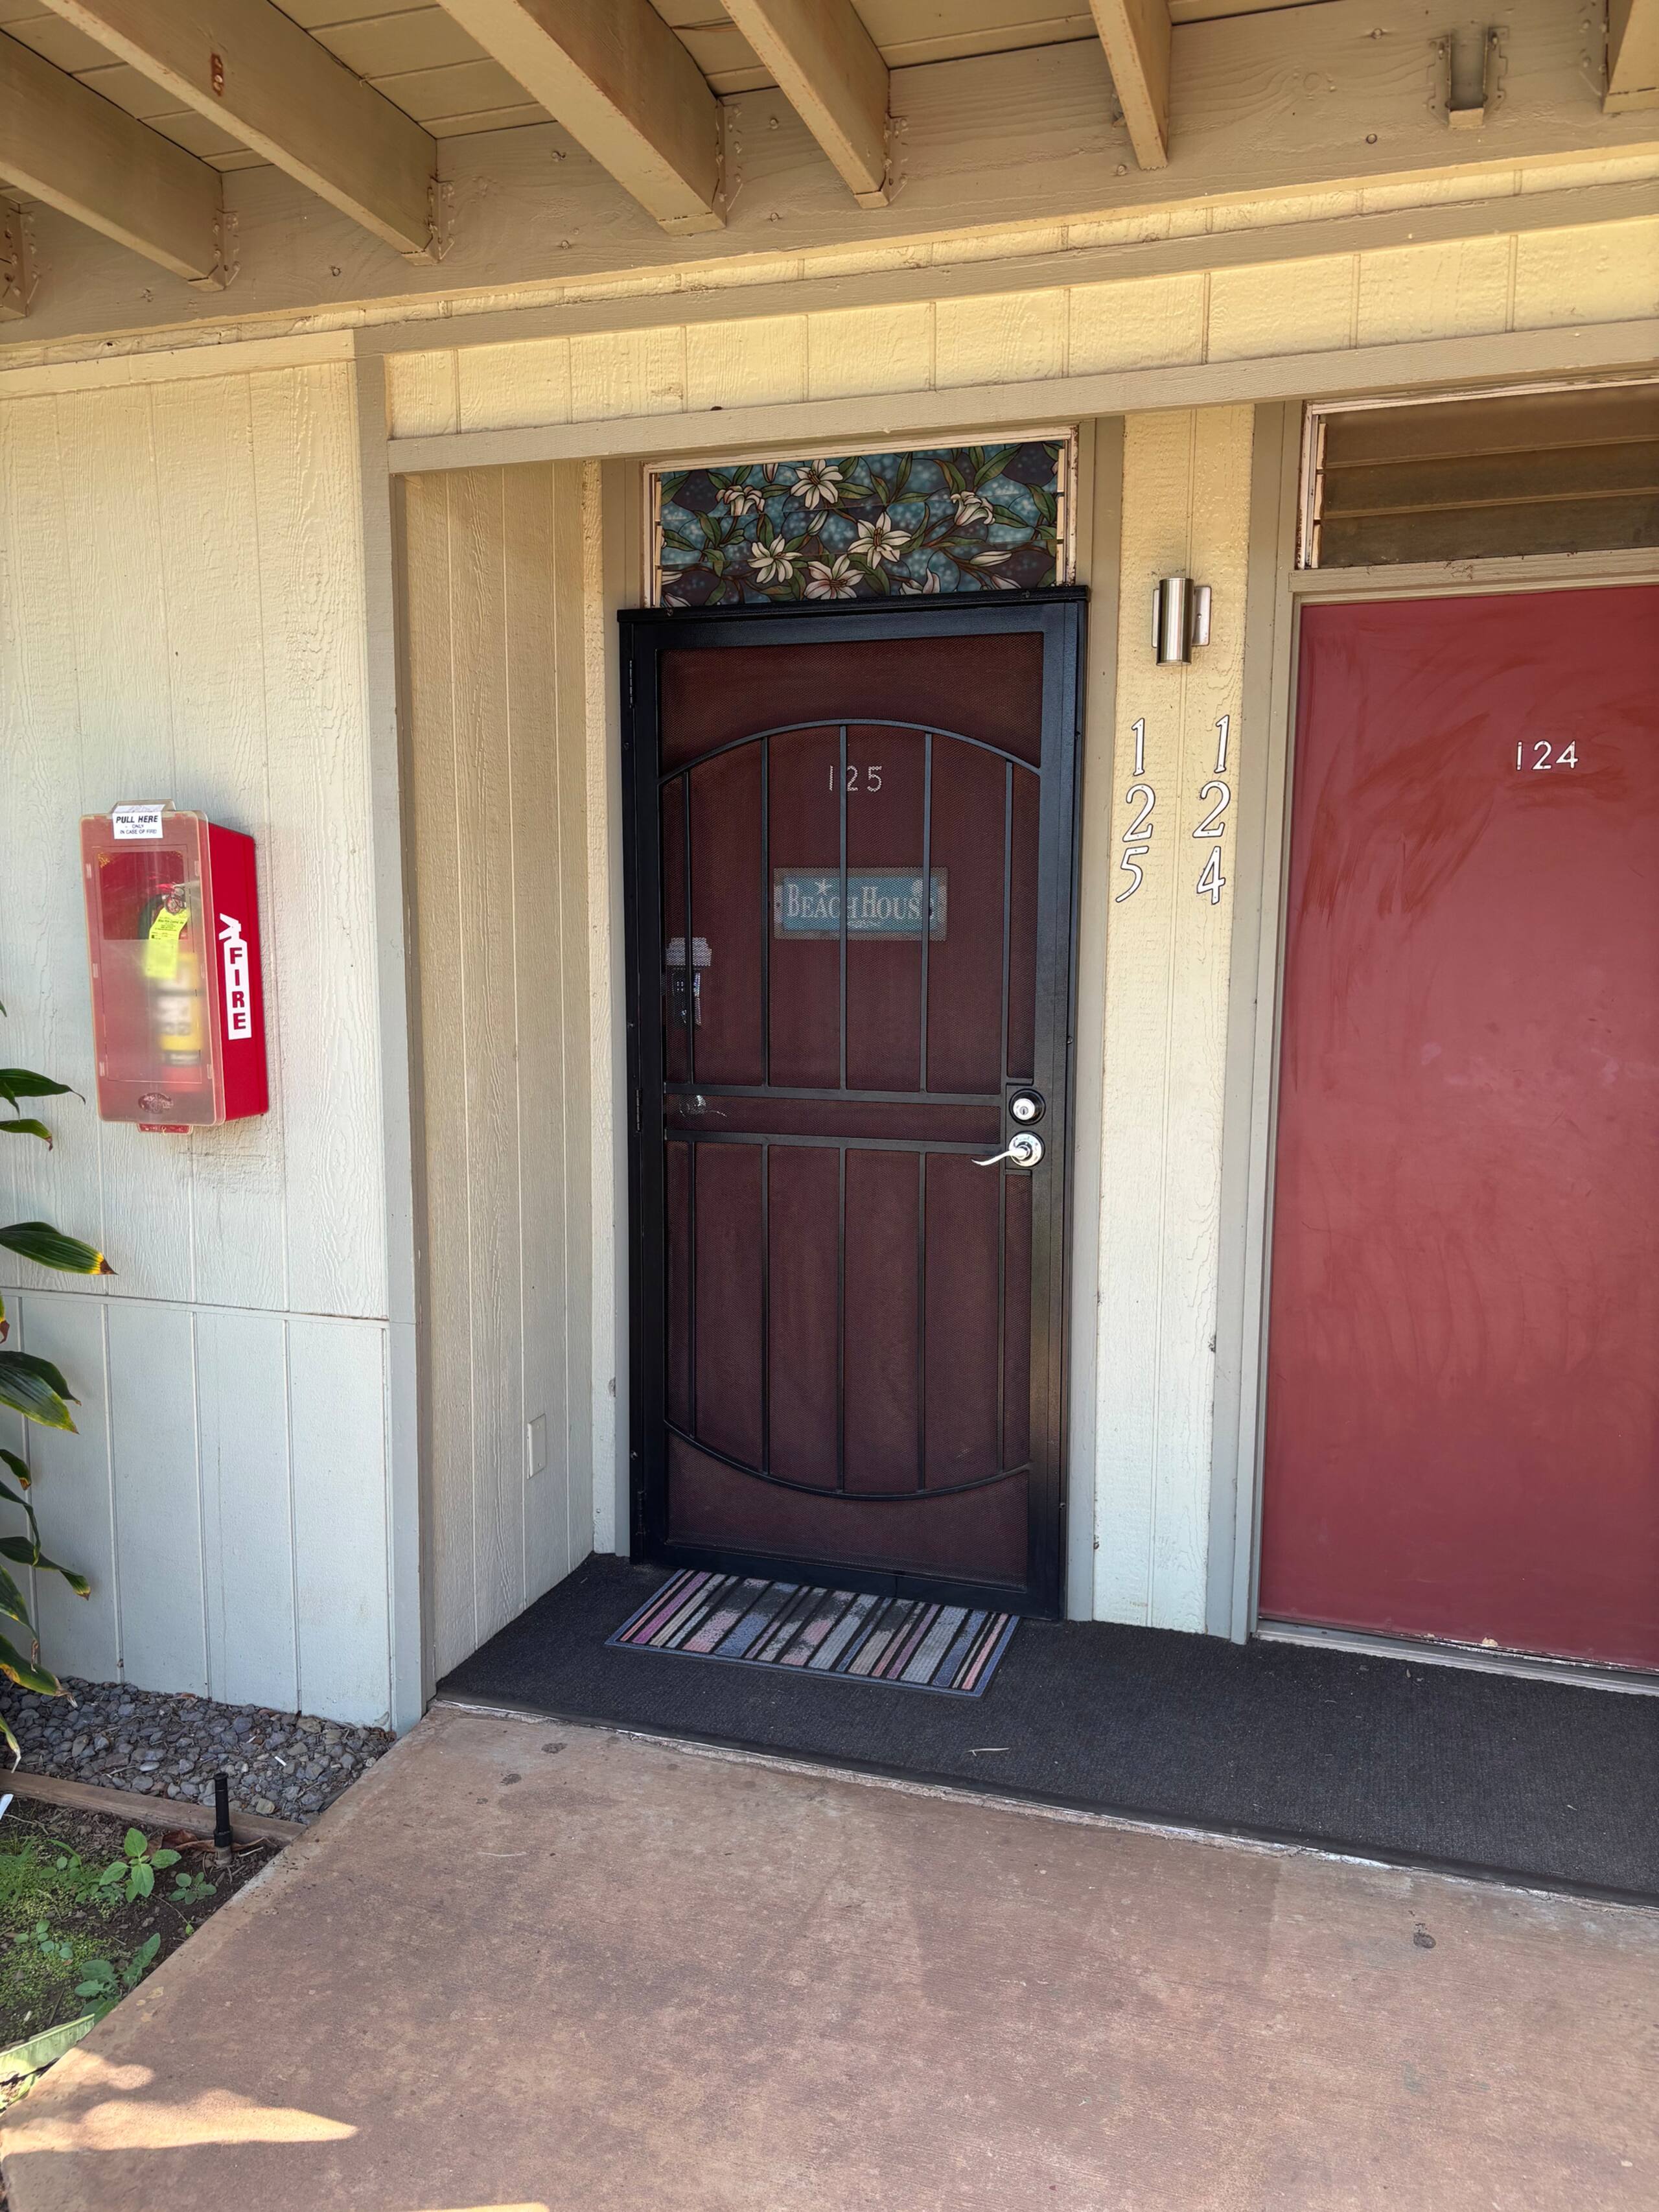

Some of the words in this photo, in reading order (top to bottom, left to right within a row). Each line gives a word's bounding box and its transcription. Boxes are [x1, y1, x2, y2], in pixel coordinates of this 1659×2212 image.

[829, 765, 883, 792] 125
[1516, 739, 1579, 771] 124
[138, 815, 159, 823] HERE
[1115, 717, 1155, 903] 125
[1192, 714, 1231, 905] 124
[229, 947, 246, 1030] FIRE
